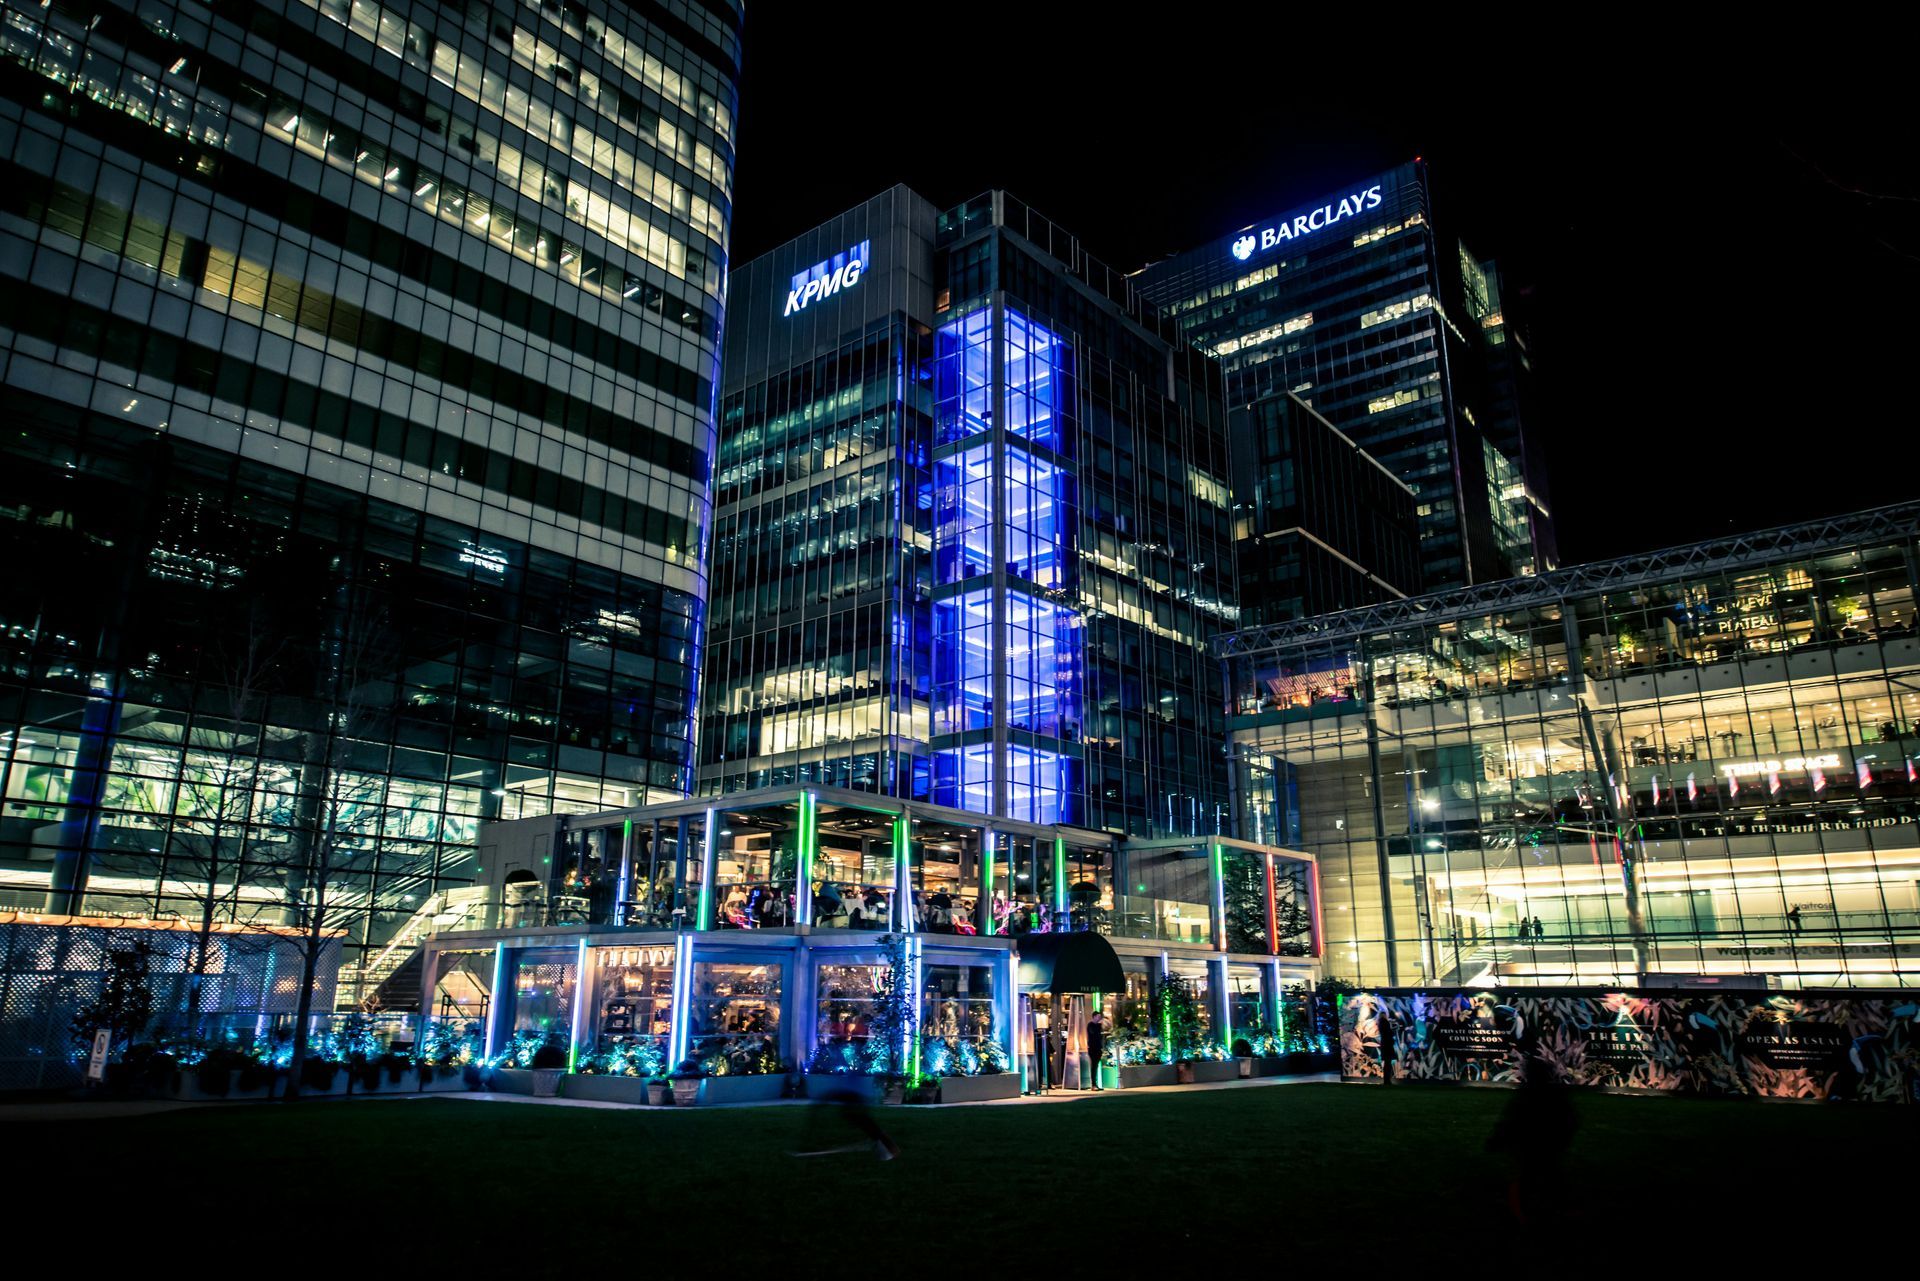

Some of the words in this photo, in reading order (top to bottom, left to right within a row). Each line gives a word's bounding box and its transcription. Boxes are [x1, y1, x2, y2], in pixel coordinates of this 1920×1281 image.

[1261, 185, 1382, 250] BARCLAYS
[784, 259, 862, 317] KPMG
[1589, 1032, 1619, 1041] THE
[1625, 1032, 1654, 1042] IVY
[1746, 1036, 1779, 1044] OPEN
[1784, 1037, 1799, 1045] AS
[1607, 1043, 1627, 1051] THE
[1630, 1043, 1650, 1051] PAR
